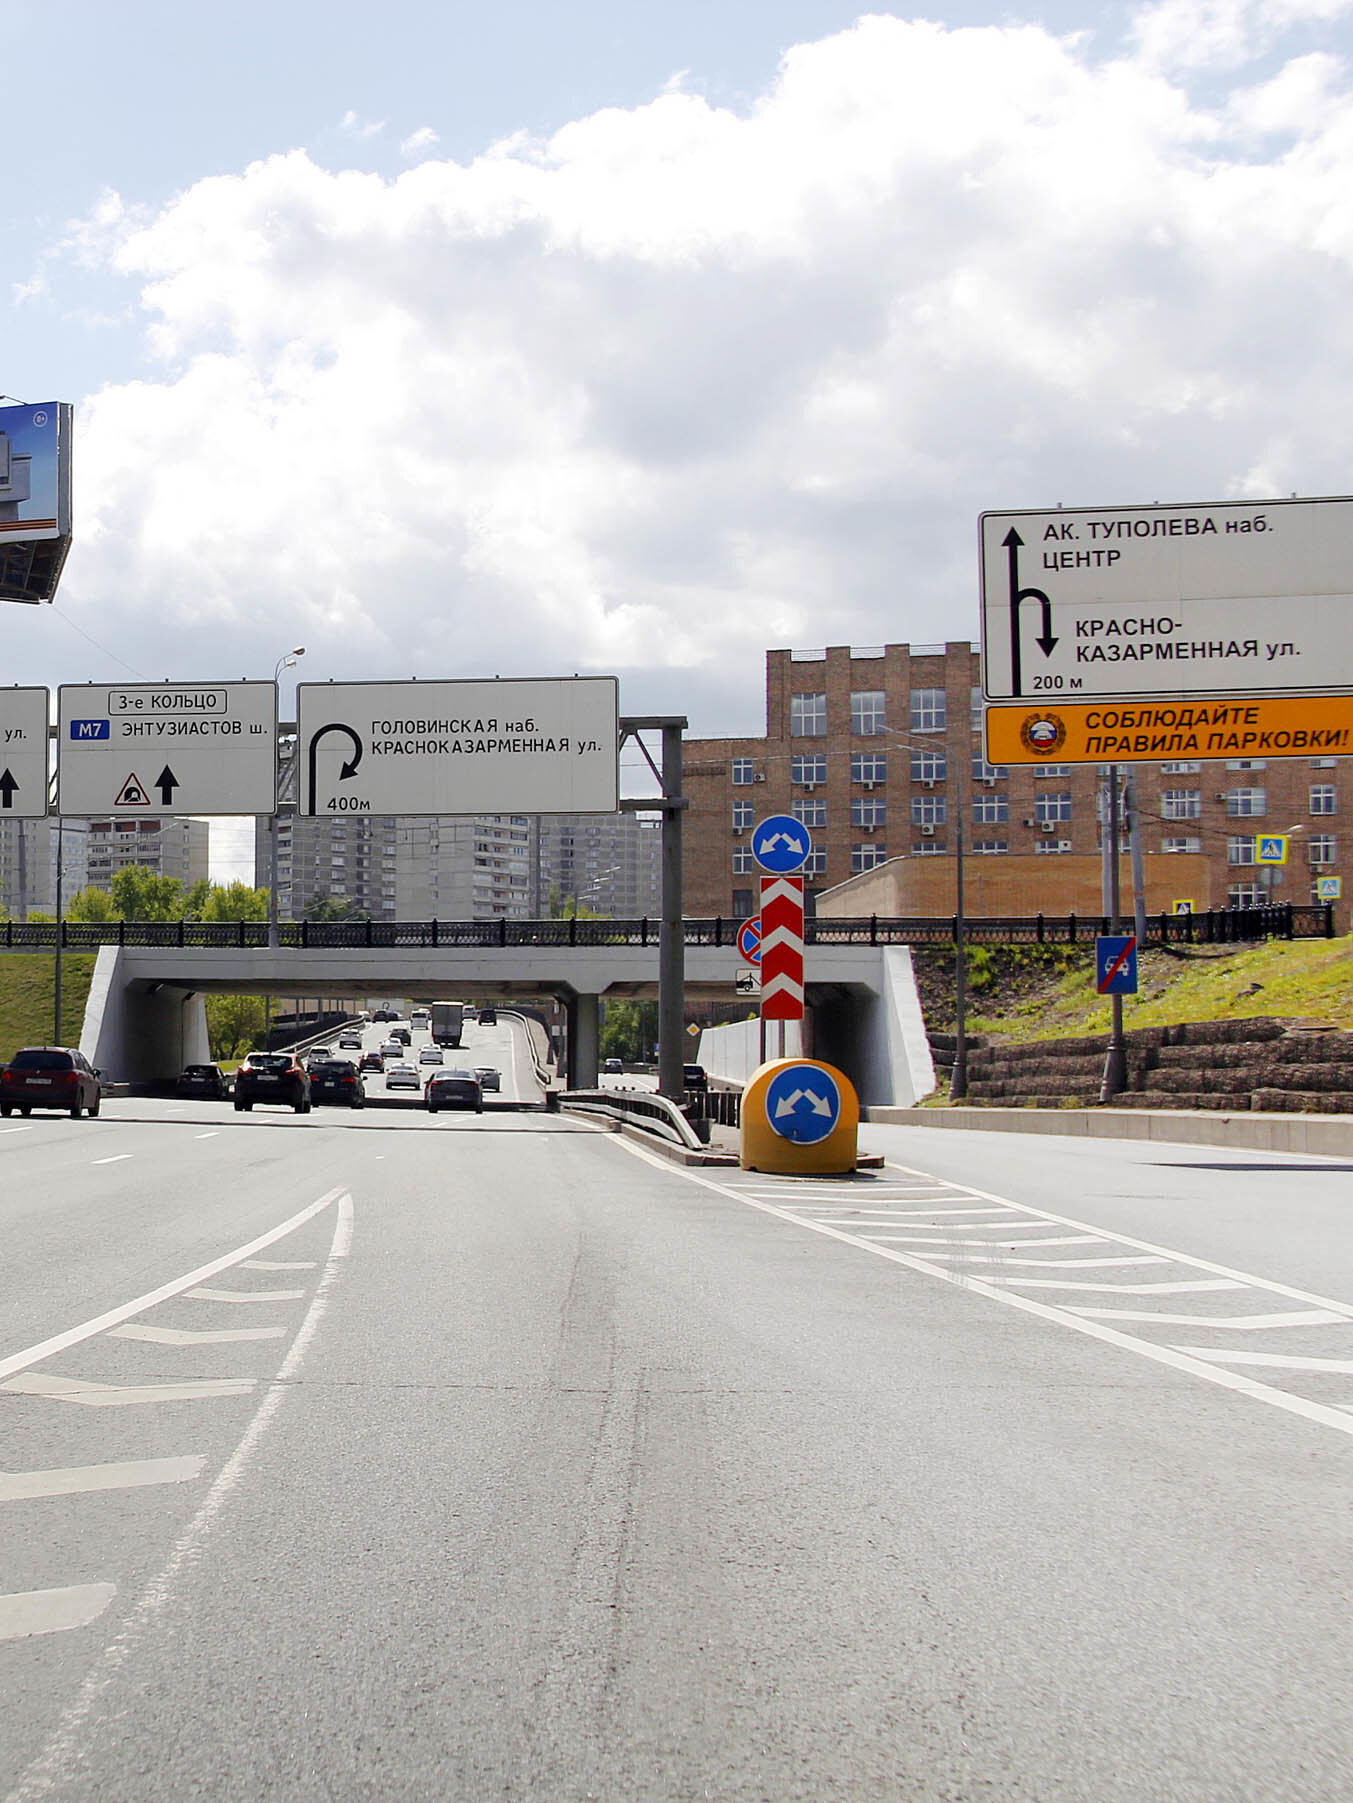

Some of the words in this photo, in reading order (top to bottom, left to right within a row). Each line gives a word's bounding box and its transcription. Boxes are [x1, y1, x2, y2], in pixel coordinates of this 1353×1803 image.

[1044, 524, 1079, 540] АК.
[1087, 518, 1217, 538] ТУПОЛЕВА
[1226, 515, 1272, 533] наб.
[1043, 549, 1121, 572] ЦЕНТР
[1077, 618, 1182, 637] КРАСНО-
[1077, 640, 1257, 662] КАЗАРМЕННАЯ
[1267, 643, 1300, 660] ул.
[1034, 676, 1063, 689] 200
[1071, 679, 1082, 688] м
[119, 696, 143, 709] 3-е
[152, 695, 216, 709] КОЛЬЦО
[372, 719, 497, 734] ГОЛОВИНСКАЯ
[506, 719, 538, 732] наб.
[1085, 706, 1260, 731] СОБЛЮДАЙТЕ
[6, 730, 26, 742] ул.
[123, 721, 241, 736] ЭНТУЗИАСТОВ
[250, 725, 267, 734] ш.
[372, 738, 568, 754] КРАСНОКАЗАРМЕННАЯ
[578, 742, 601, 754] ул.
[1086, 734, 1198, 753] ПРАВИЛА
[1207, 730, 1349, 749] ПАРКОВКИ!
